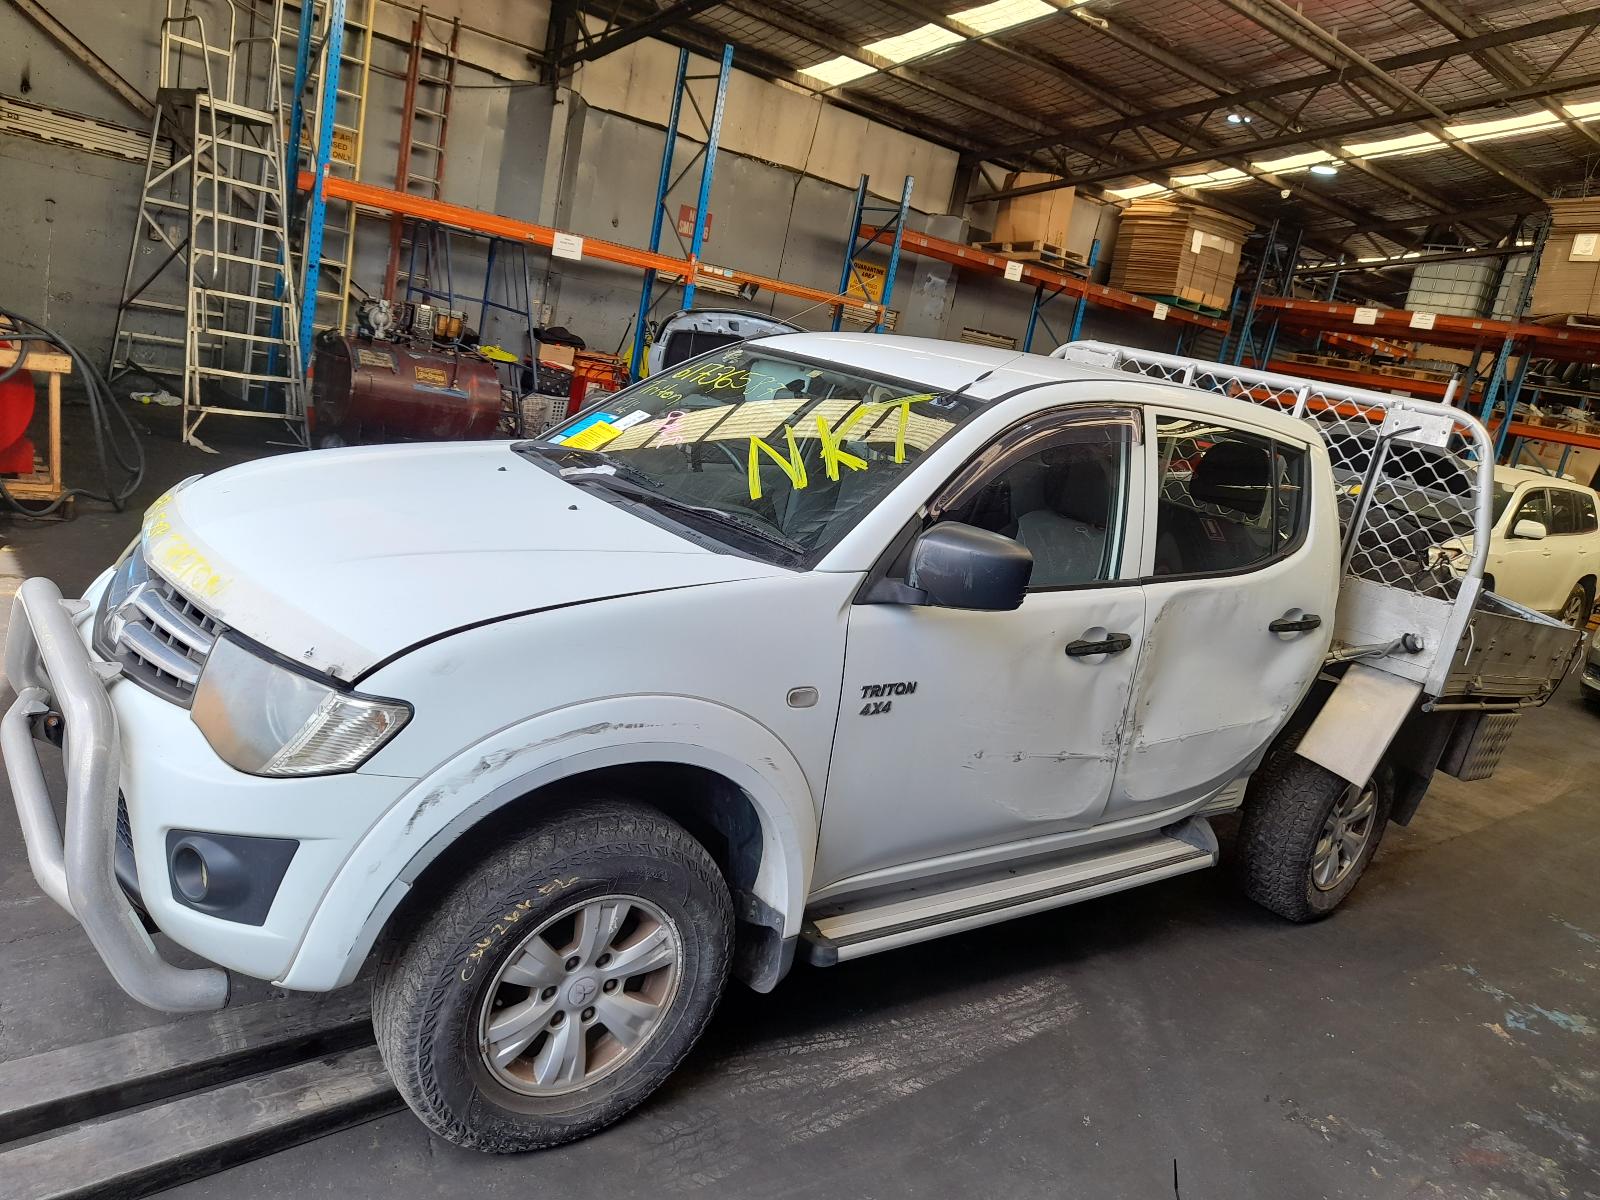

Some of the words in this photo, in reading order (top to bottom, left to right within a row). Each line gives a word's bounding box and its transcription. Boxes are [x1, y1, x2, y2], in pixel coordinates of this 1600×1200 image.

[853, 262, 885, 276] QUARANTINE
[860, 681, 918, 700] TRITON
[859, 701, 893, 716] 4X4
